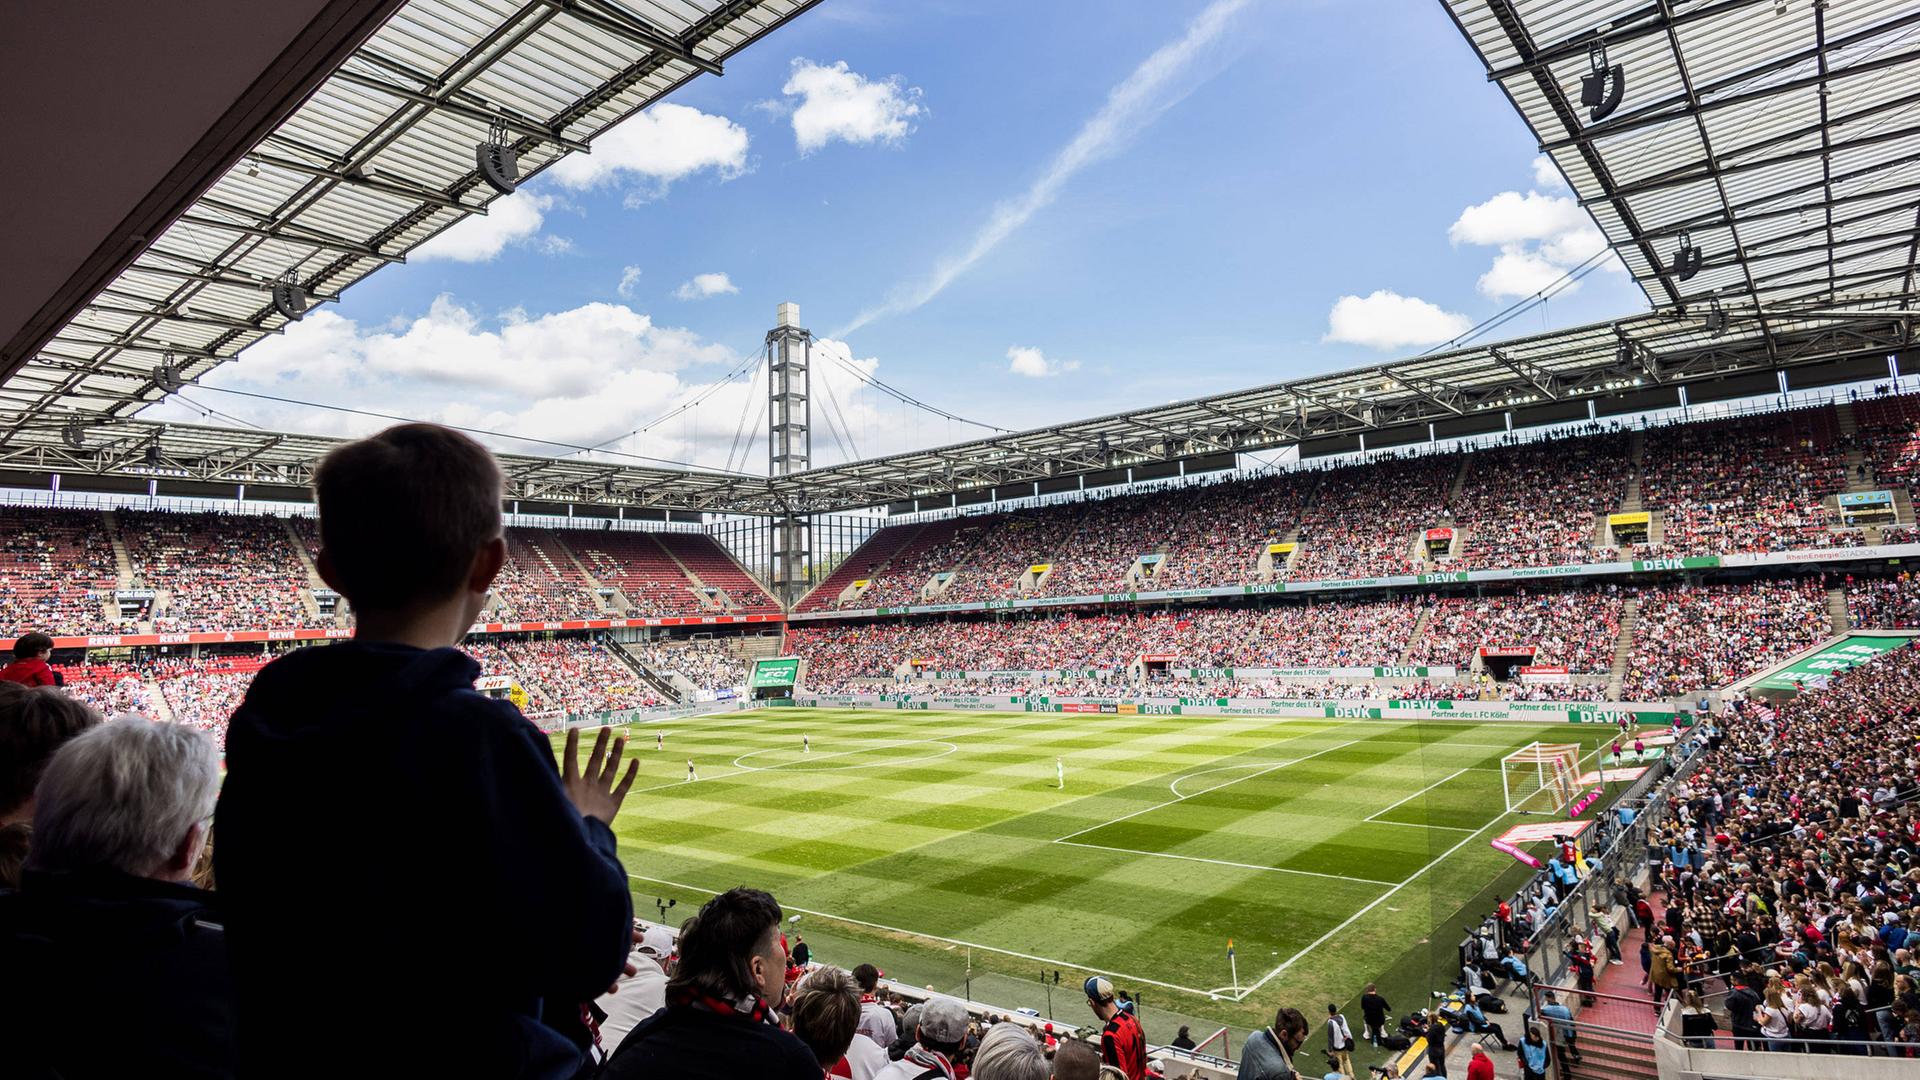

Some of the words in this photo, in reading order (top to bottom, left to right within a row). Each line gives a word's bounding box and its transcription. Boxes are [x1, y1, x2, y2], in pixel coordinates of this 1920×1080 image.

[1786, 550, 1878, 560] RheinEnergieSTADION
[1643, 559, 1686, 571] DEVK
[1512, 569, 1537, 577] Partner
[1425, 573, 1459, 583] DEVK
[1251, 583, 1278, 593] DEVK
[1109, 593, 1131, 602] DEVK
[502, 623, 521, 631] REWE
[610, 619, 627, 627] REWE
[268, 631, 295, 639] REWE
[325, 629, 351, 637] REWE
[88, 636, 122, 646] REWE
[159, 634, 190, 643] REWE
[941, 671, 960, 679] DEVK
[1066, 669, 1090, 679] DEVK
[1197, 668, 1226, 678] DEVK
[1383, 667, 1419, 677] DEVK
[484, 680, 505, 688] HIT
[744, 699, 768, 709] DEVK
[902, 702, 922, 710] DEVK
[1188, 697, 1217, 706] DEVK
[1399, 700, 1438, 709] DEVK
[1031, 704, 1056, 712] DEVK
[1101, 704, 1117, 713] bwin
[1145, 705, 1173, 715] DEVK
[1509, 703, 1540, 711] Partner
[1576, 704, 1598, 712] Köln!
[1335, 707, 1370, 718] DEVK
[1431, 710, 1458, 718] Partner
[1490, 711, 1510, 719] Köln!
[608, 713, 634, 724] DEVK
